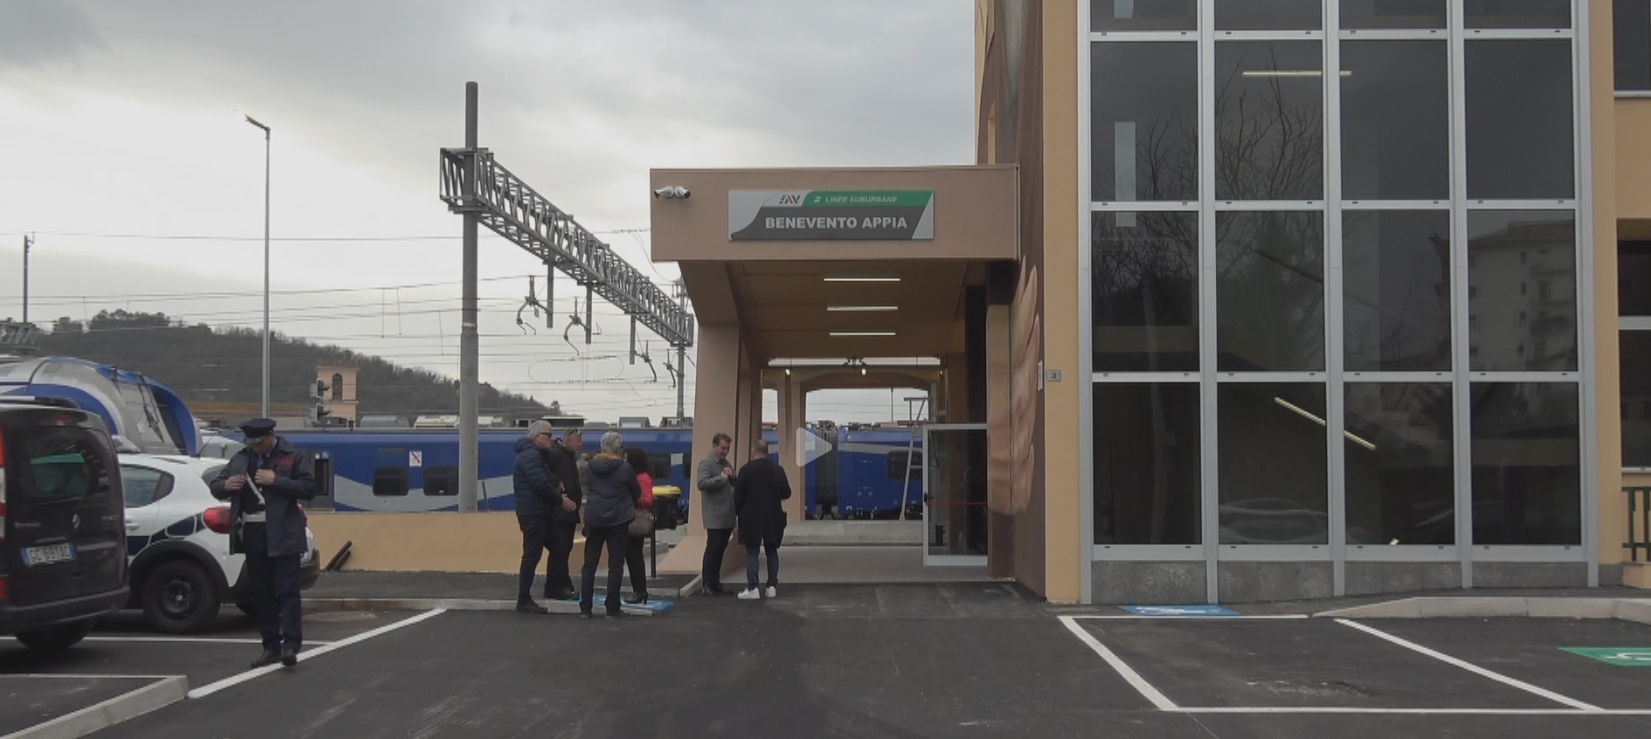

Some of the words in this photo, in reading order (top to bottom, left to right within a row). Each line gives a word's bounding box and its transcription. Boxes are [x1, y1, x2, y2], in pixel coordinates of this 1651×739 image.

[825, 195, 848, 204] LINEE
[850, 195, 898, 204] SUBURBANE
[765, 217, 858, 229] BENEVENTO
[861, 217, 908, 229] APPIA
